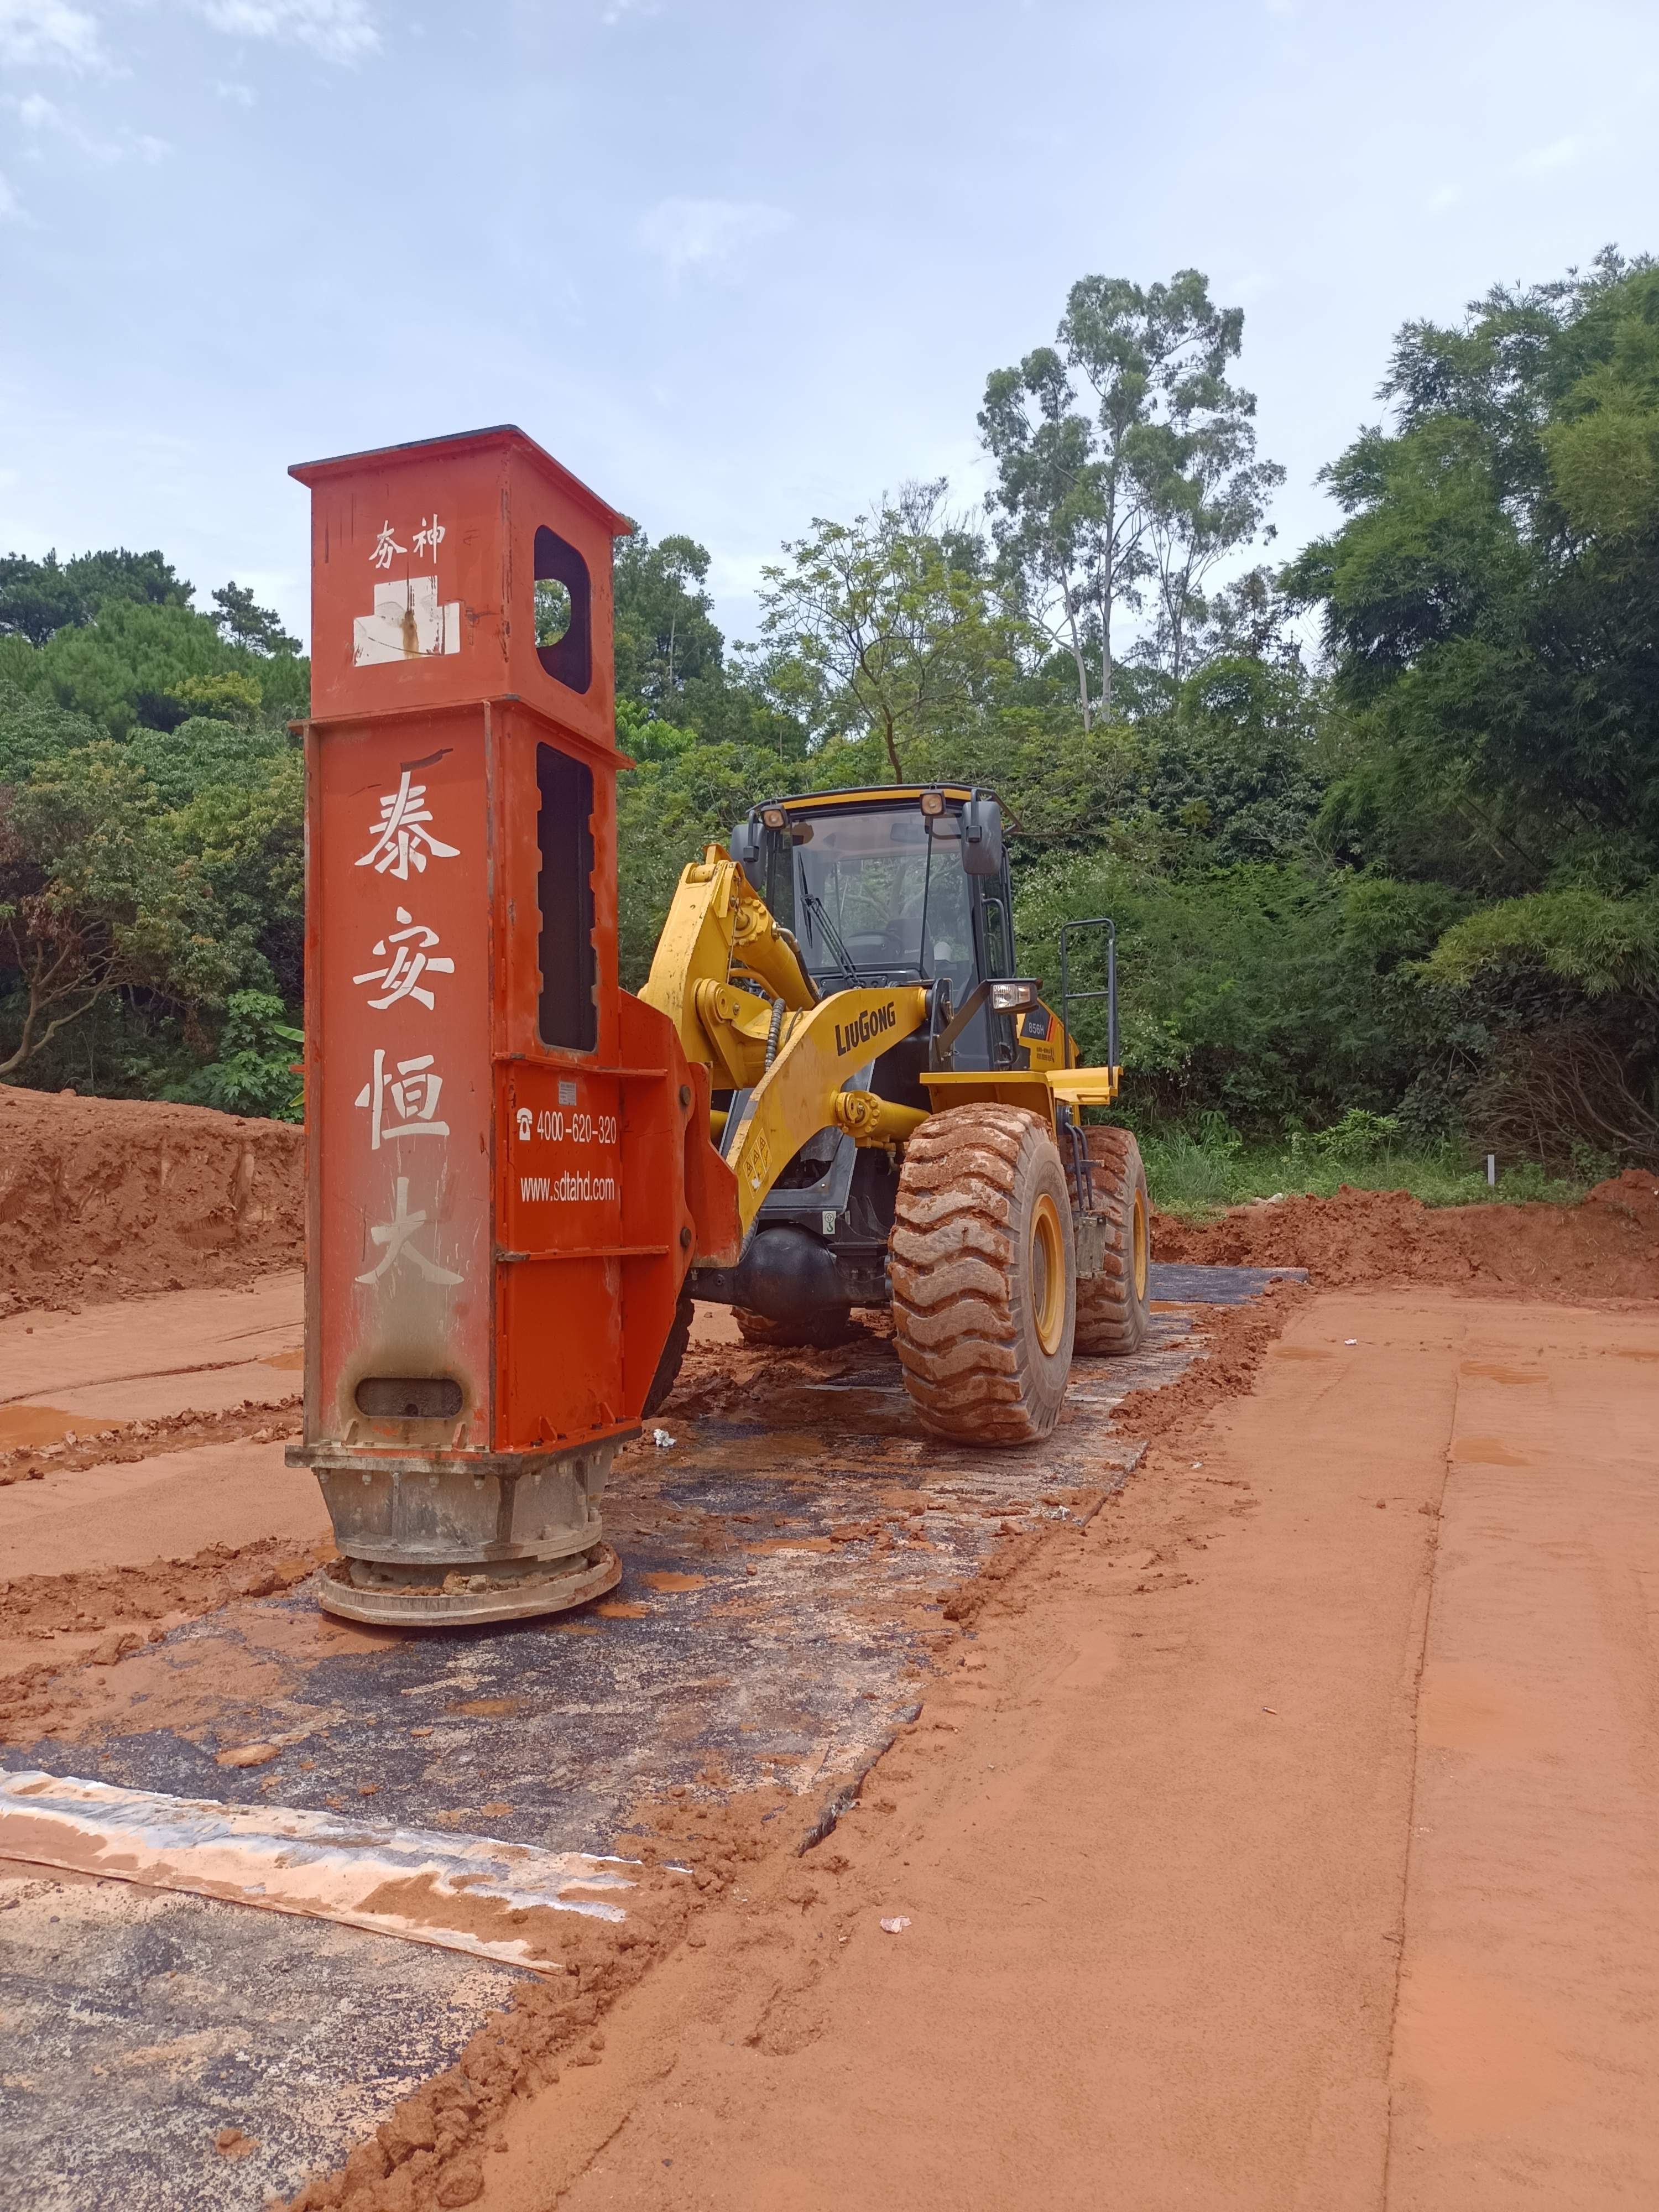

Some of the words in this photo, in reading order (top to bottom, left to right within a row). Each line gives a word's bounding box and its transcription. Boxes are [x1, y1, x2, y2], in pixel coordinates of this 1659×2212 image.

[369, 514, 445, 568] 夯神
[352, 771, 465, 1286] 泰安恒大
[1029, 1022, 1045, 1035] 856H
[537, 1110, 617, 1144] 4000-620-320
[520, 1170, 614, 1202] www.sdtahd.com
